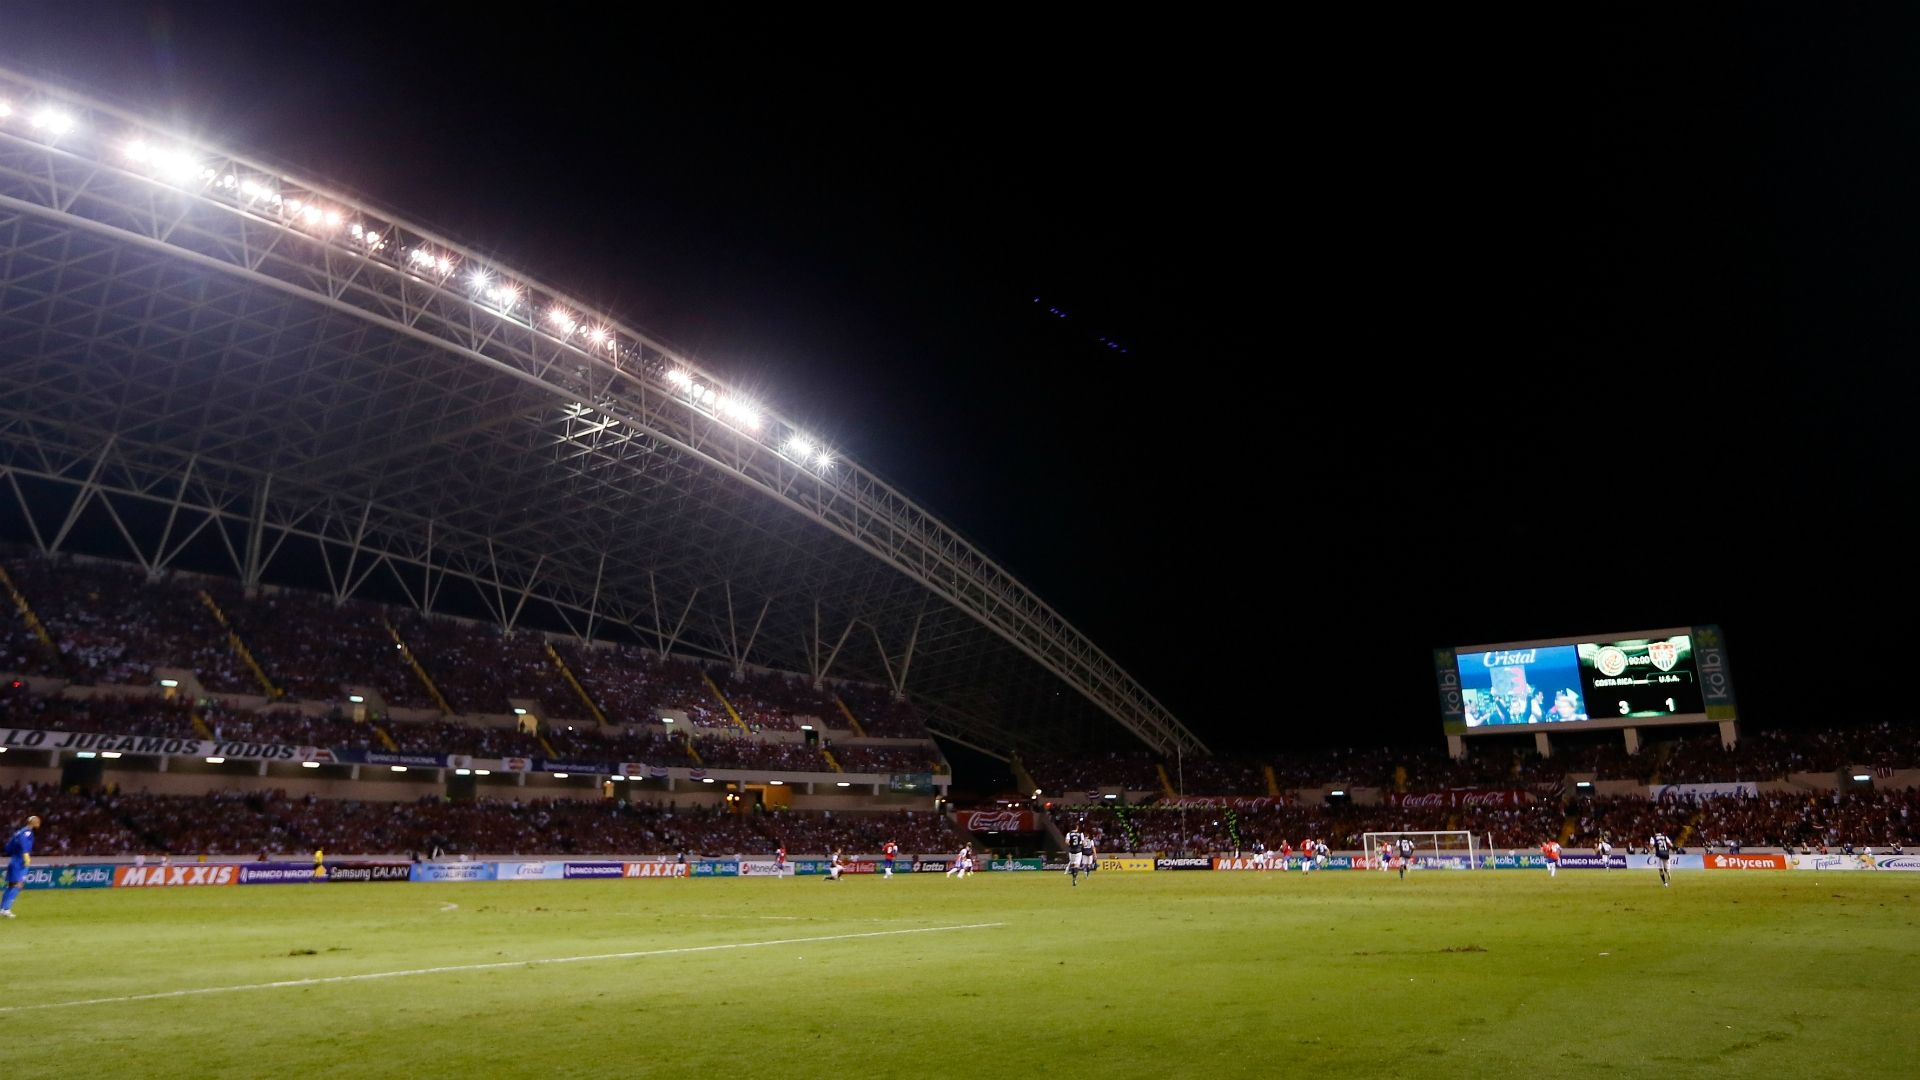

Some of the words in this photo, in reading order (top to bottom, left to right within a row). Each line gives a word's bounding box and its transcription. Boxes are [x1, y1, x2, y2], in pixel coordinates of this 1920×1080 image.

[1483, 649, 1536, 667] Cristal
[1594, 679, 1616, 687] COSTA
[1617, 677, 1633, 685] RICA
[1618, 700, 1630, 715] 3
[1665, 697, 1676, 712] 1
[5, 729, 46, 746] LO
[55, 733, 201, 755] JUGAMOS
[211, 742, 296, 760] TODOS
[1072, 836, 1079, 846] 3
[1657, 839, 1667, 851] 21
[1102, 861, 1123, 871] EPA
[1157, 858, 1209, 867] POWERADE
[1562, 858, 1588, 866] BANCO
[1728, 857, 1775, 869] Plycem
[1813, 858, 1842, 870] Tropical
[121, 866, 232, 887] MAXXIS
[248, 870, 282, 879] BANCO
[331, 867, 371, 880] Samsung
[373, 866, 409, 877] GALAXY
